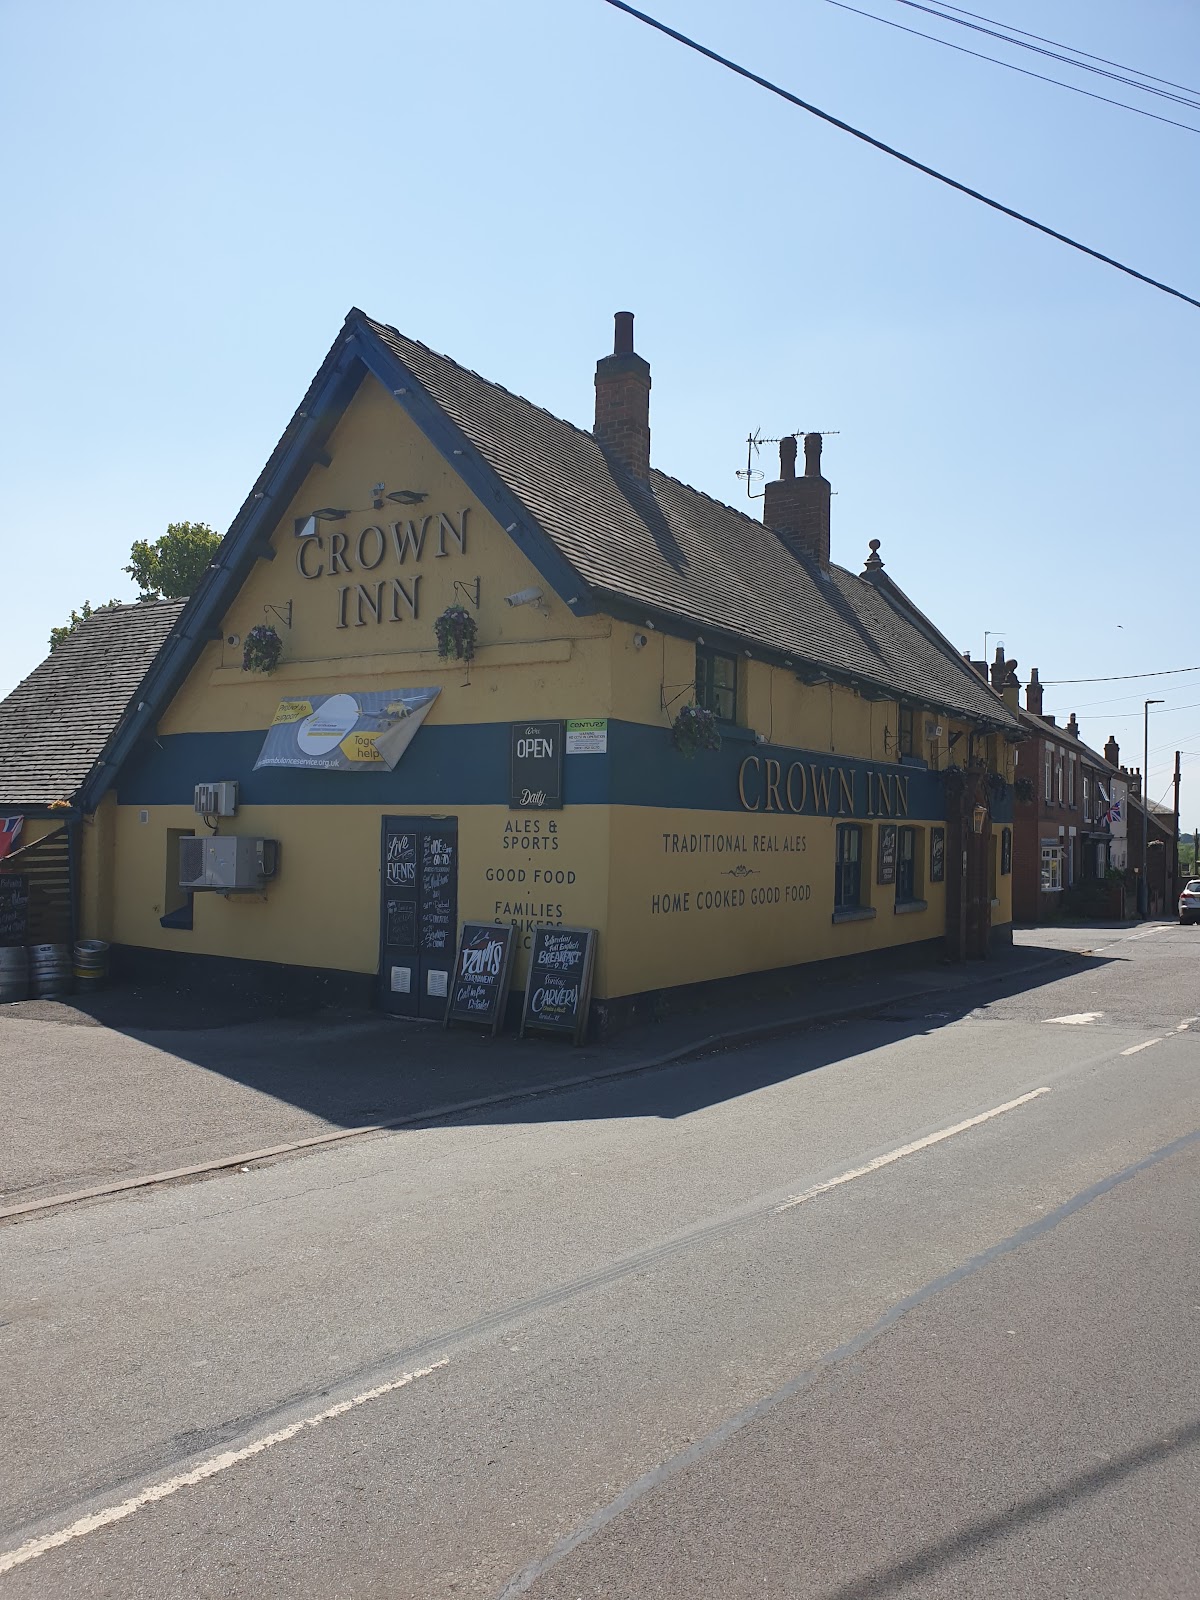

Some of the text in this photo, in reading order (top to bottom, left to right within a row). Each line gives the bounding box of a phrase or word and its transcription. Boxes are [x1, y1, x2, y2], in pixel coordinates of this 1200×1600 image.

[295, 507, 471, 579] CROWN
[335, 574, 423, 629] INN
[357, 747, 380, 760] help
[517, 738, 553, 758] OPEN
[738, 755, 909, 816] CROWN INN
[519, 788, 548, 807] Daily
[504, 819, 558, 834] ALES &
[502, 835, 559, 850] SPORTS
[662, 833, 808, 853] TRADITIONAL REAL ALES
[386, 861, 417, 885] EVENTS
[485, 868, 576, 885] GOOD FOOD
[651, 884, 812, 914] HOME COOKED GOOD FOOD
[495, 901, 563, 918] FAMILIES
[537, 950, 582, 966] BREAKFAST
[531, 984, 579, 1015] CARVERY
